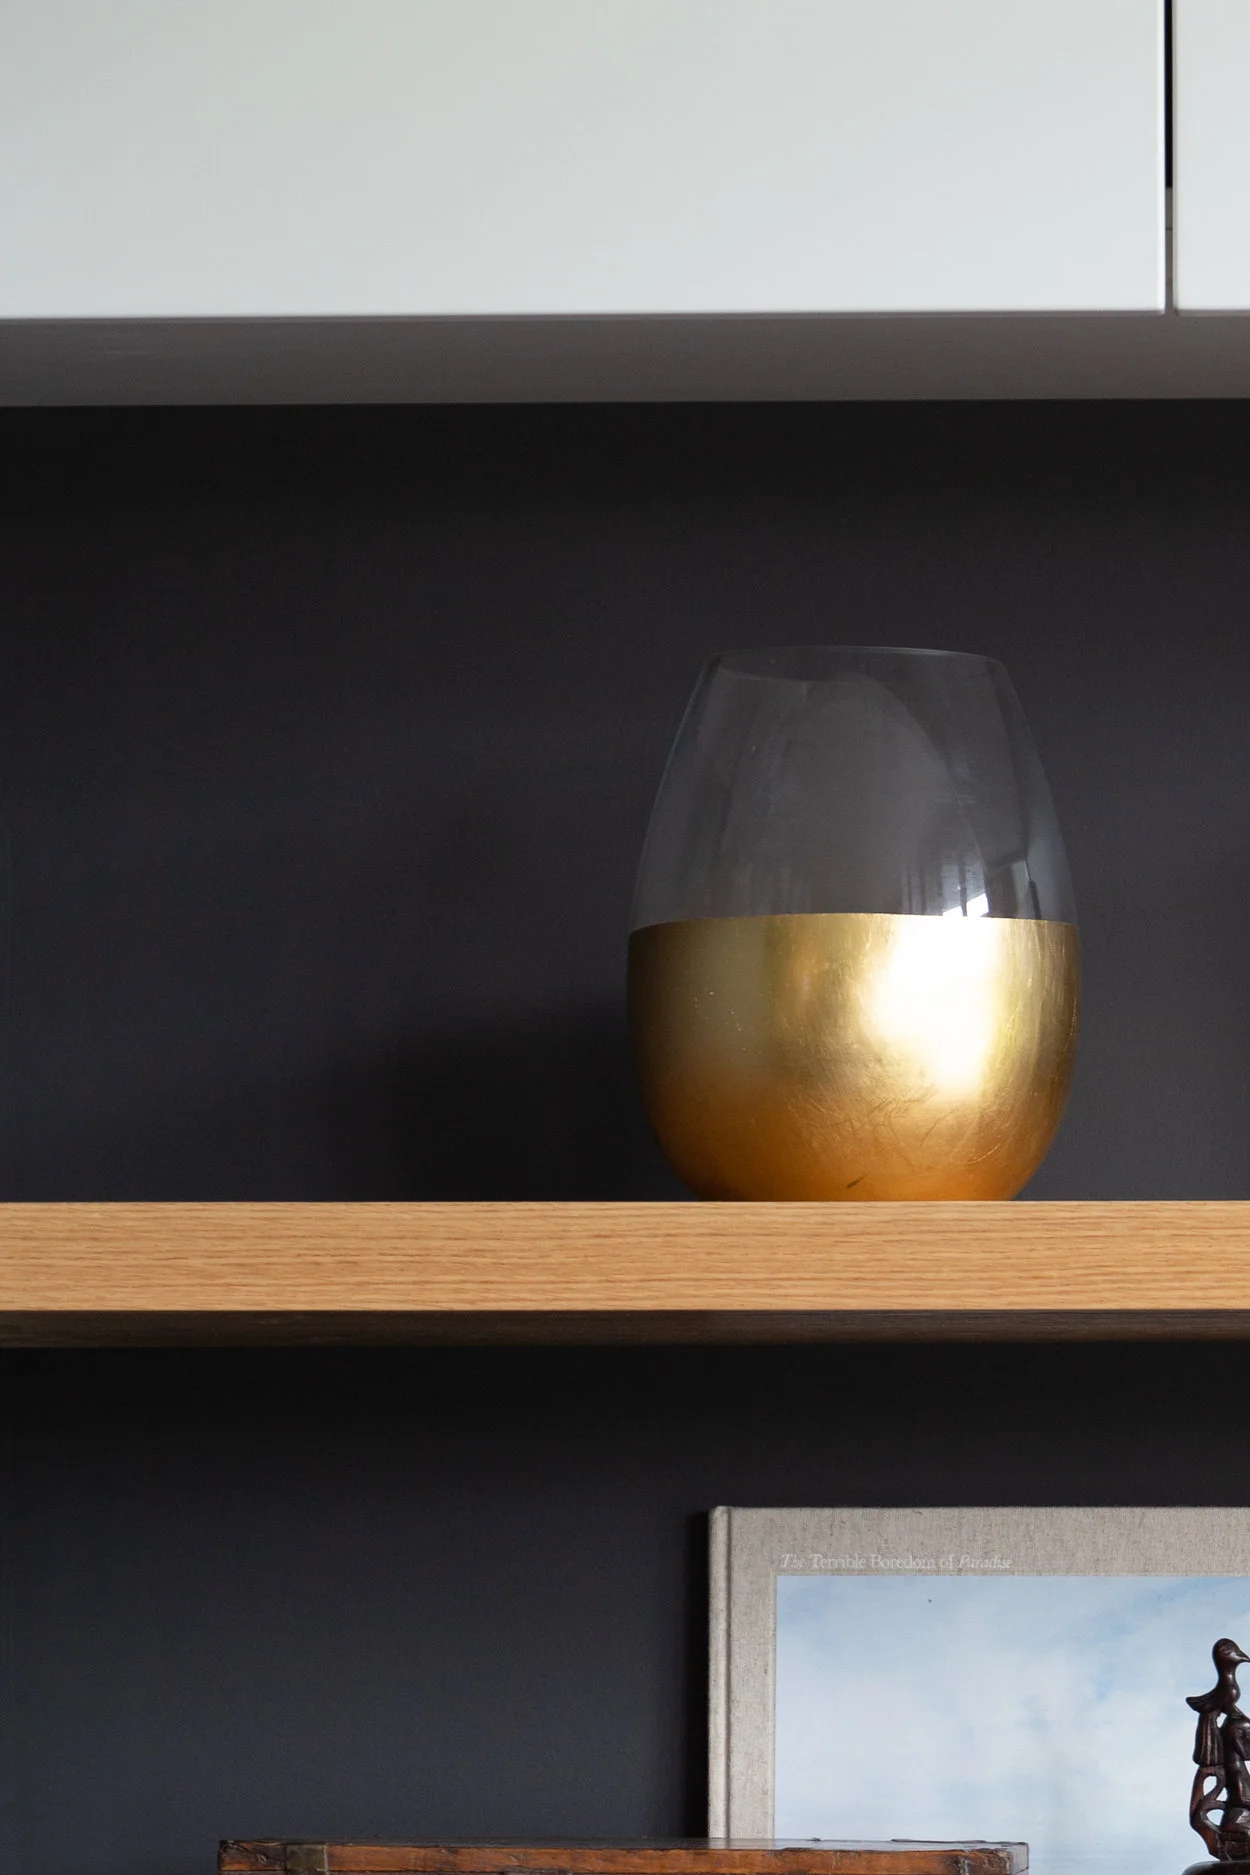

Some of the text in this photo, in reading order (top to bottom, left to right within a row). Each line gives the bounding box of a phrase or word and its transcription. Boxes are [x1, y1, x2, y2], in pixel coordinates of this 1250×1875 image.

[809, 1553, 866, 1569] Terrible
[871, 1554, 937, 1569] Boredom
[940, 1554, 956, 1569] of
[957, 1555, 1012, 1569] Paradise
